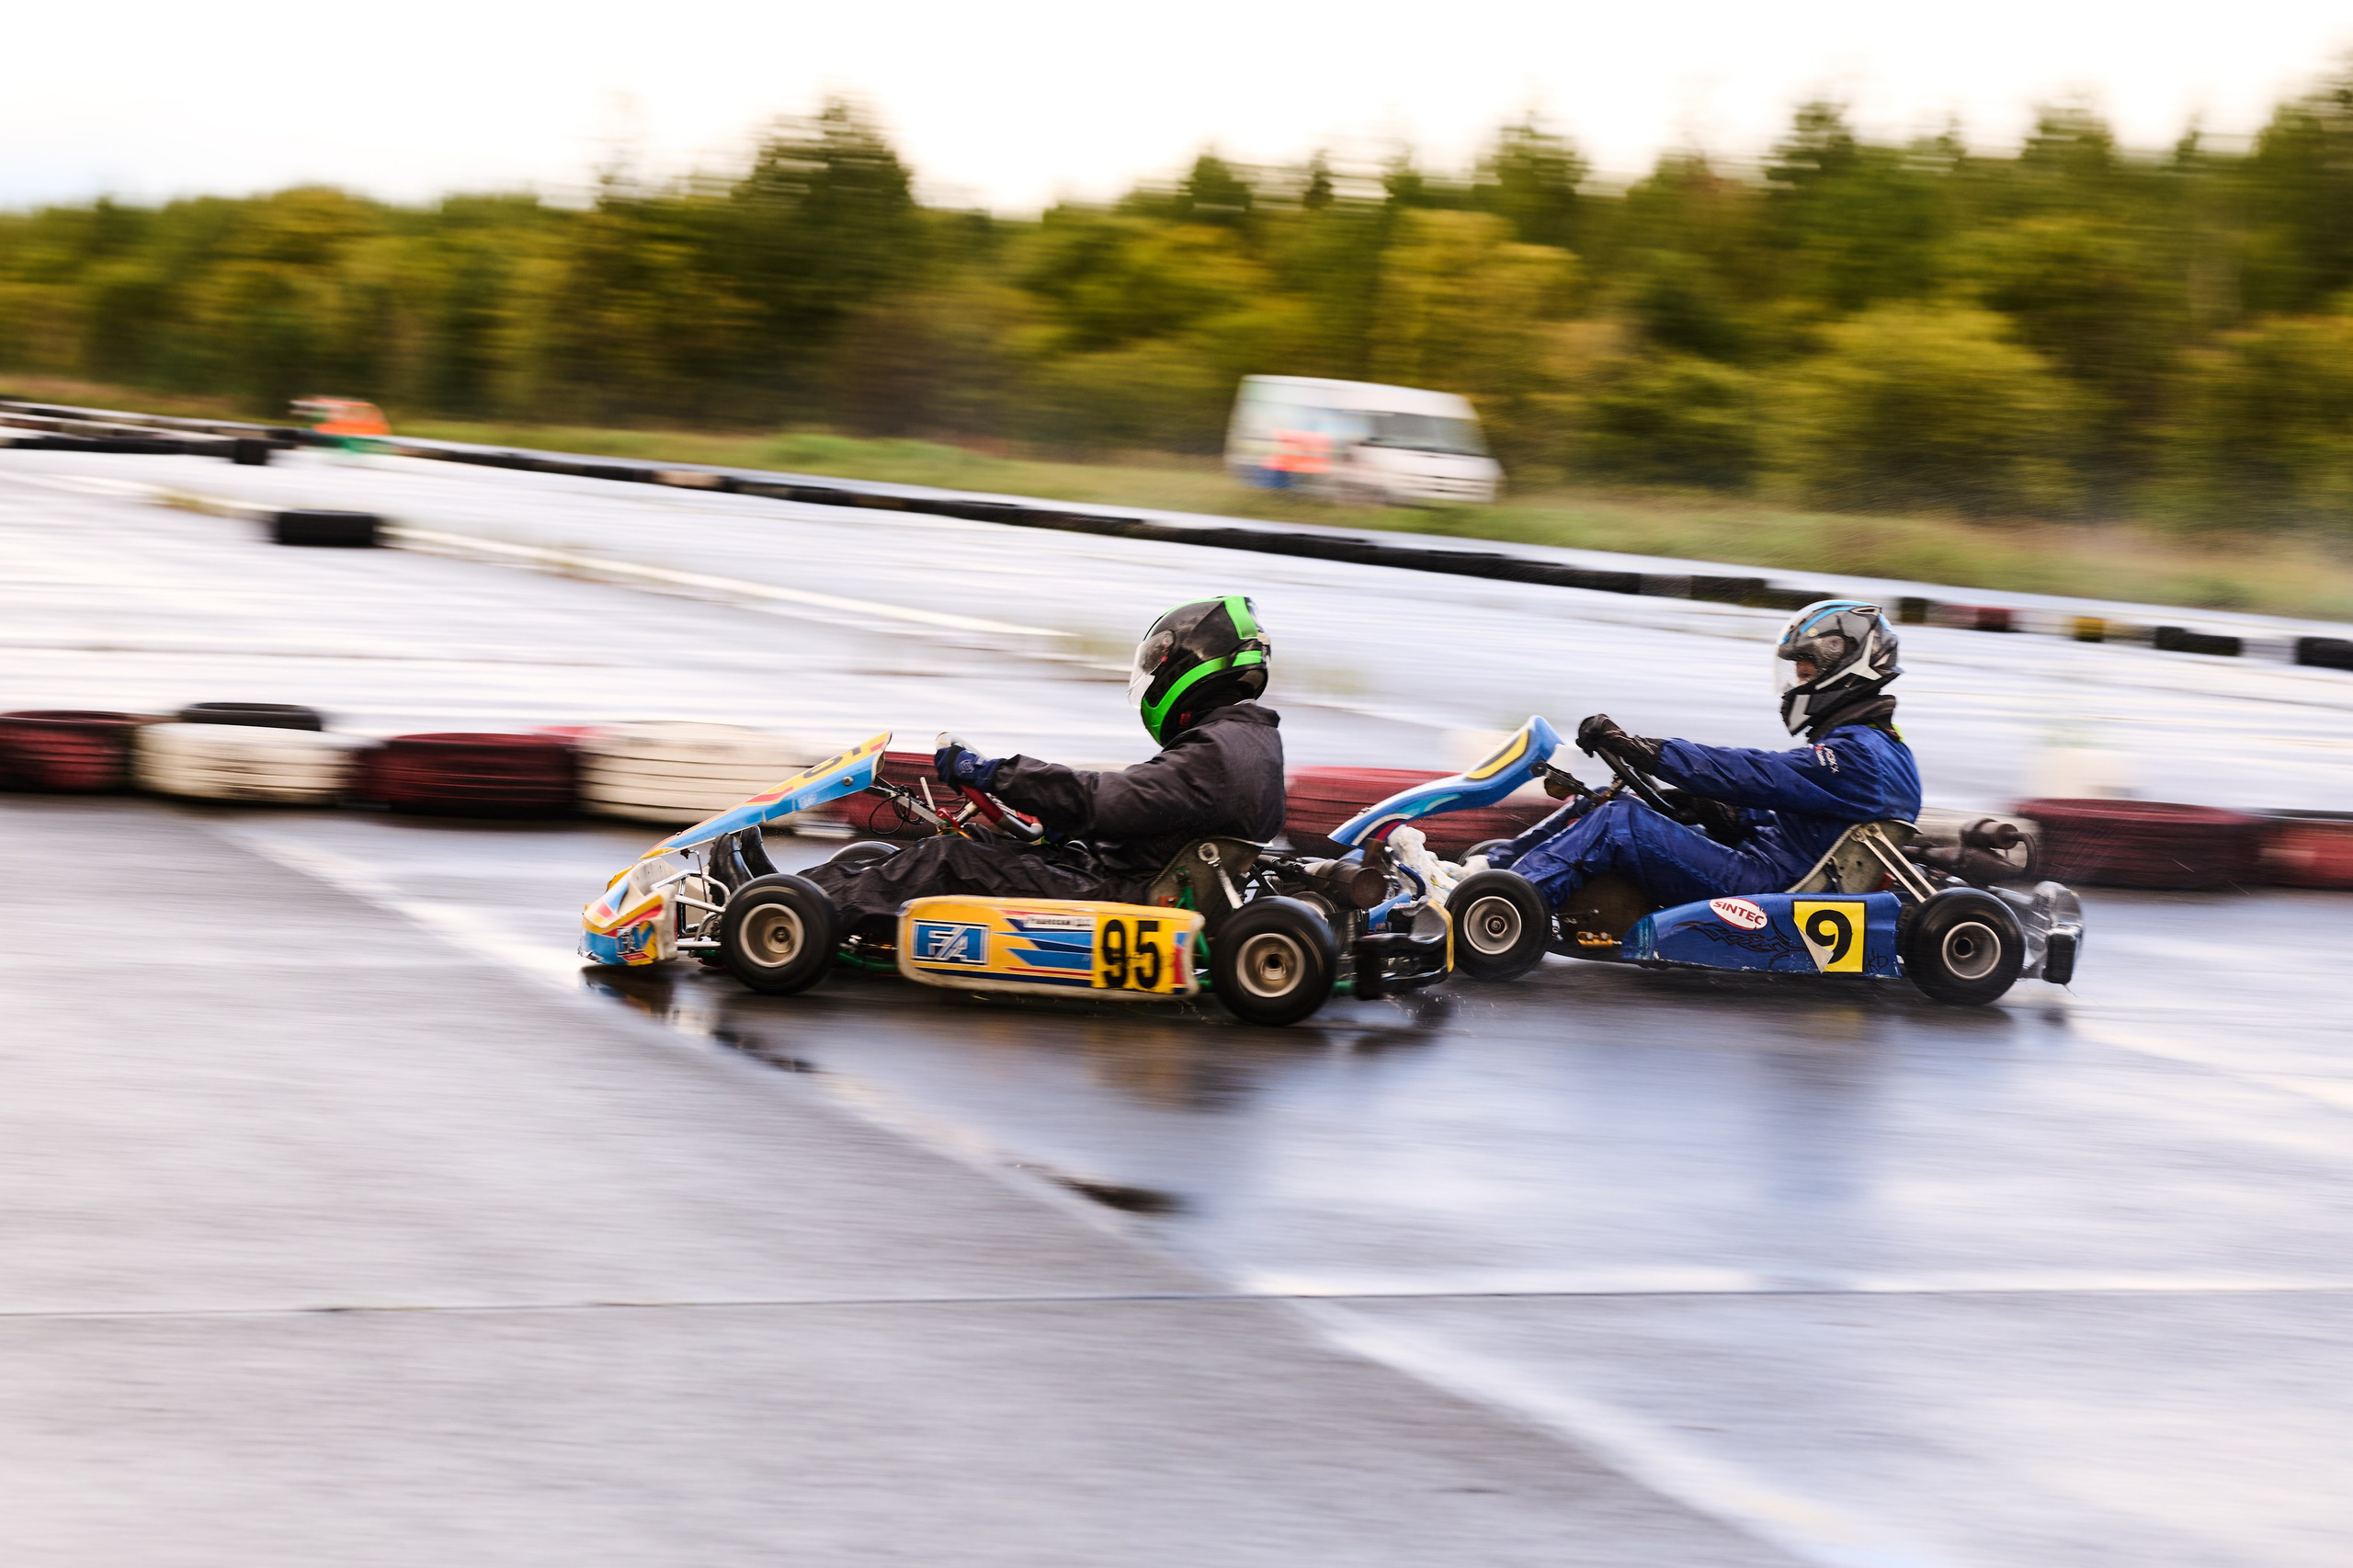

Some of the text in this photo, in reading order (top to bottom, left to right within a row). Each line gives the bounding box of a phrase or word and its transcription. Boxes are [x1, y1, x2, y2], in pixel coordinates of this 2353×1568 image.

[1713, 901, 1765, 926] SINTEC
[1805, 909, 1853, 964] 9
[1103, 919, 1160, 990] 95
